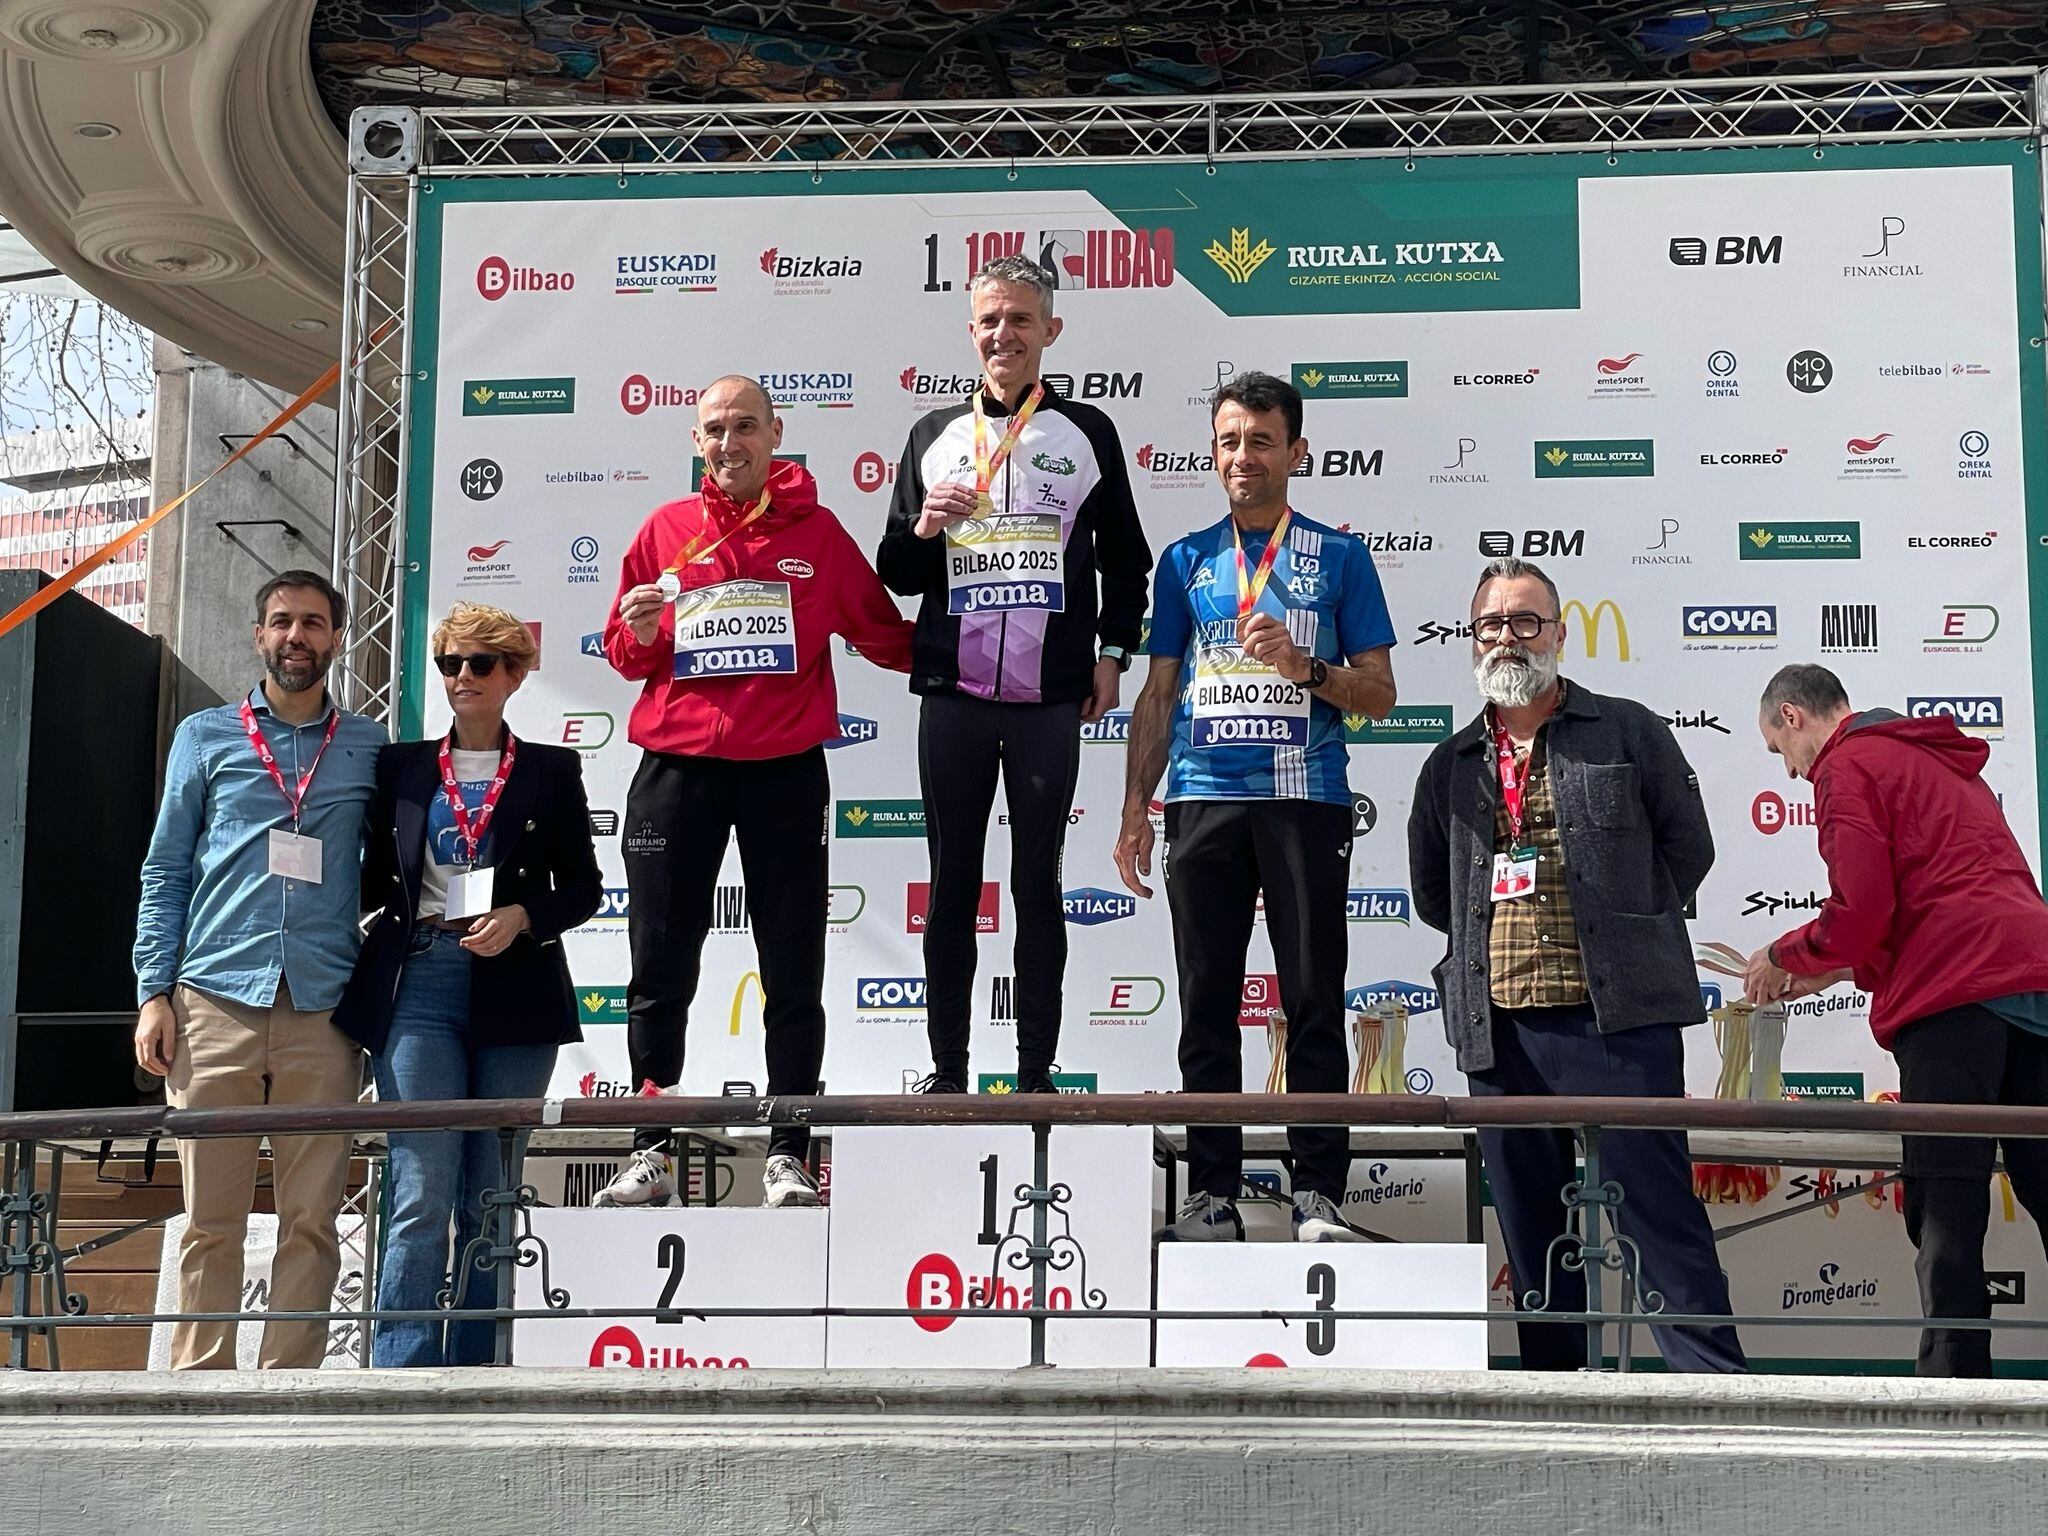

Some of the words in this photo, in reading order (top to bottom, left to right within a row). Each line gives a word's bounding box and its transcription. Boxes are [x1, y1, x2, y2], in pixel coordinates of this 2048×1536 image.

[1288, 246, 1387, 268] RURAL
[1395, 241, 1504, 265] KUTXA
[1715, 235, 1783, 265] BM
[617, 255, 717, 273] EUSKADI
[776, 256, 862, 278] Bizkaia
[1843, 265, 1923, 277] FINANCIAL
[482, 263, 576, 295] Bilbao
[616, 275, 657, 287] BASQUE
[660, 274, 717, 286] COUNTRY
[1289, 274, 1341, 286] GIZARTE
[1344, 273, 1396, 284] EKINTZA
[1404, 271, 1453, 283] ACCIÓN
[1455, 271, 1501, 282] SOCIAL
[1329, 374, 1361, 382] RURAL
[1364, 373, 1400, 382] KUTXA
[1879, 365, 1942, 376] telebilbao
[759, 373, 853, 390] EUSKADI
[916, 374, 984, 394] Bizkai
[1082, 372, 1143, 399] BM
[1454, 375, 1471, 385] EL
[1473, 373, 1535, 385] CORREO
[1597, 377, 1645, 385] emteSPORT
[1707, 380, 1738, 388] OREKA
[498, 391, 530, 400] RURAL
[532, 390, 567, 399] KUTXA
[628, 382, 701, 408] Bilba
[772, 393, 798, 402] SQUE
[800, 392, 853, 402] COUNTRY
[1706, 389, 1740, 397] DENTAL
[1152, 452, 1219, 471] Bizka
[1321, 450, 1384, 477] BM
[1572, 453, 1606, 461] RURAL
[1609, 451, 1645, 460] KUTXA
[1700, 455, 1718, 465] EL
[1720, 453, 1783, 465] CORREO
[1847, 457, 1895, 465] emteSPORT
[1958, 461, 1991, 469] OREKA
[546, 471, 604, 482] telebilbao
[1430, 474, 1489, 483] FINANCIAL
[1958, 470, 1993, 478] DENTAL
[1522, 530, 1585, 557] BM
[1777, 535, 1812, 543] RURAL
[1814, 534, 1852, 543] KUTXA
[1908, 538, 1926, 548] EL
[1928, 536, 1992, 548] CORREO
[467, 564, 511, 572] emteSPORT
[782, 562, 812, 574] Serrano
[953, 552, 1015, 576] BILBAO
[1019, 550, 1058, 571] 2025
[1632, 556, 1693, 565] FINANCIAL
[569, 565, 599, 574] OREKA
[568, 575, 600, 583] DENTAL
[681, 616, 743, 641] BILBAO
[746, 616, 787, 634] 2025
[1687, 610, 1773, 634] GOYA
[1413, 620, 1474, 645] Spiu
[1199, 684, 1259, 706] BILBAO
[1263, 684, 1304, 705] 2025
[1080, 718, 1129, 739] aiku
[1371, 718, 1405, 727] RURAL
[1407, 718, 1445, 727] KUTXA
[1664, 710, 1731, 734] iuk
[873, 812, 906, 821] RURAL
[908, 811, 927, 821] KUT
[1758, 801, 1818, 826] Bilb
[628, 838, 667, 846] SERRANO
[1063, 898, 1131, 915] RTIACH
[1346, 895, 1402, 917] aiku
[861, 982, 927, 1007] GOY
[1784, 991, 1866, 1017] romedario
[1785, 1086, 1814, 1095] URAL
[1816, 1085, 1855, 1095] KUTXA
[1345, 1178, 1423, 1204] romedario
[978, 1154, 1002, 1245] 1
[655, 1233, 686, 1324] 2
[1782, 1278, 1877, 1310] Dromedario
[1306, 1263, 1336, 1356] 3
